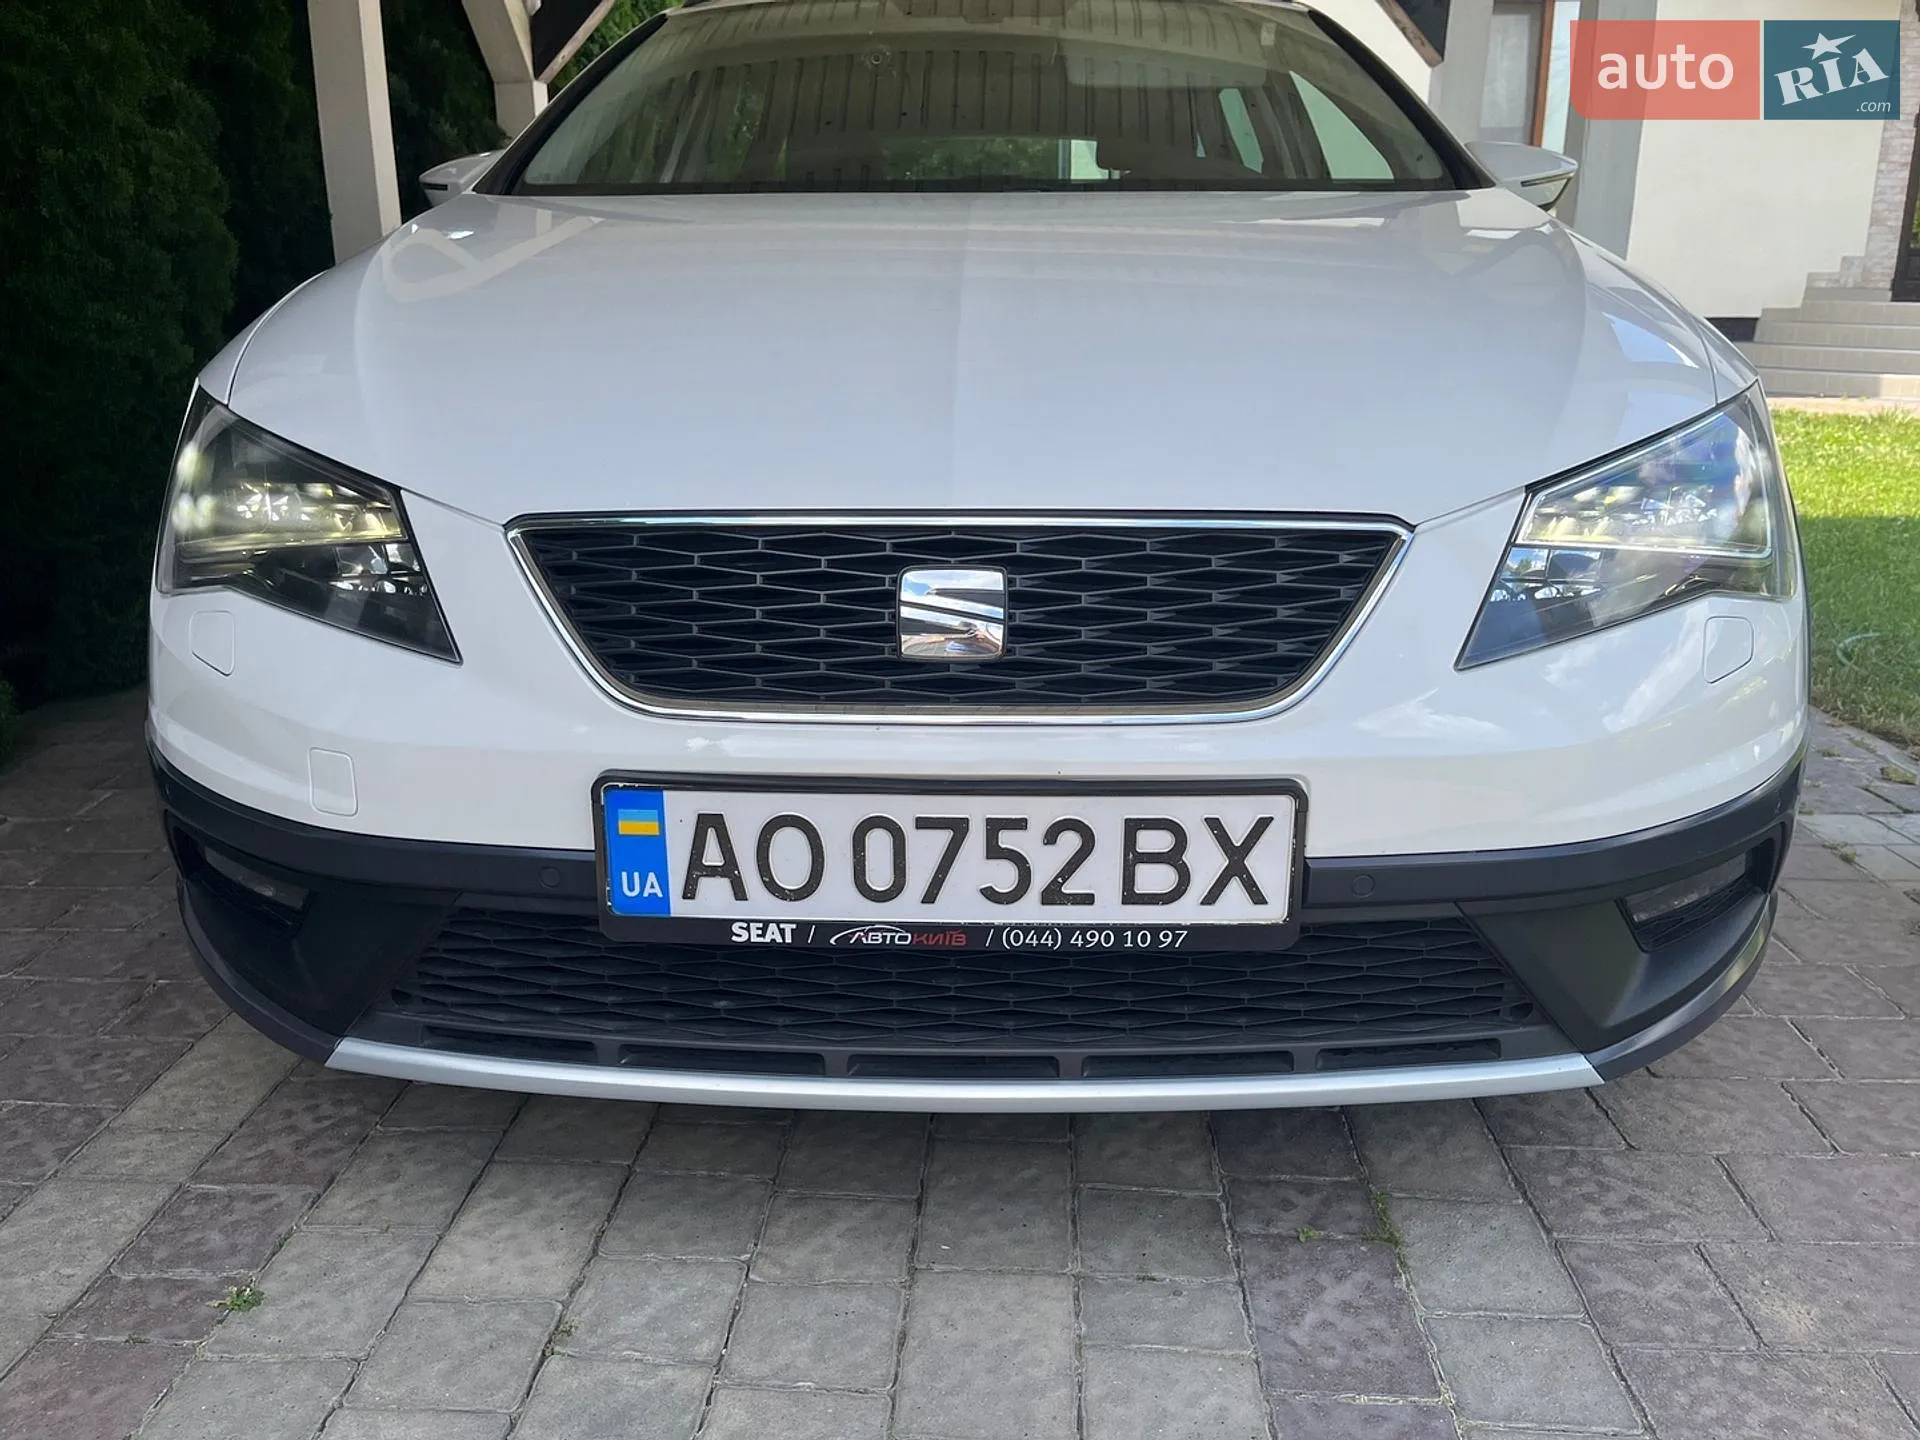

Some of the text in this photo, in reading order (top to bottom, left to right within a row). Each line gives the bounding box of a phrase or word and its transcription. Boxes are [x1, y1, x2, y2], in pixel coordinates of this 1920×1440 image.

[681, 812, 1275, 906] AO 0752 BX
[621, 871, 663, 899] UA
[730, 921, 797, 944] SEAT
[1001, 928, 1062, 950] (044)
[1070, 930, 1115, 948] 490
[1122, 930, 1151, 948] 10
[1157, 930, 1189, 949] 97
